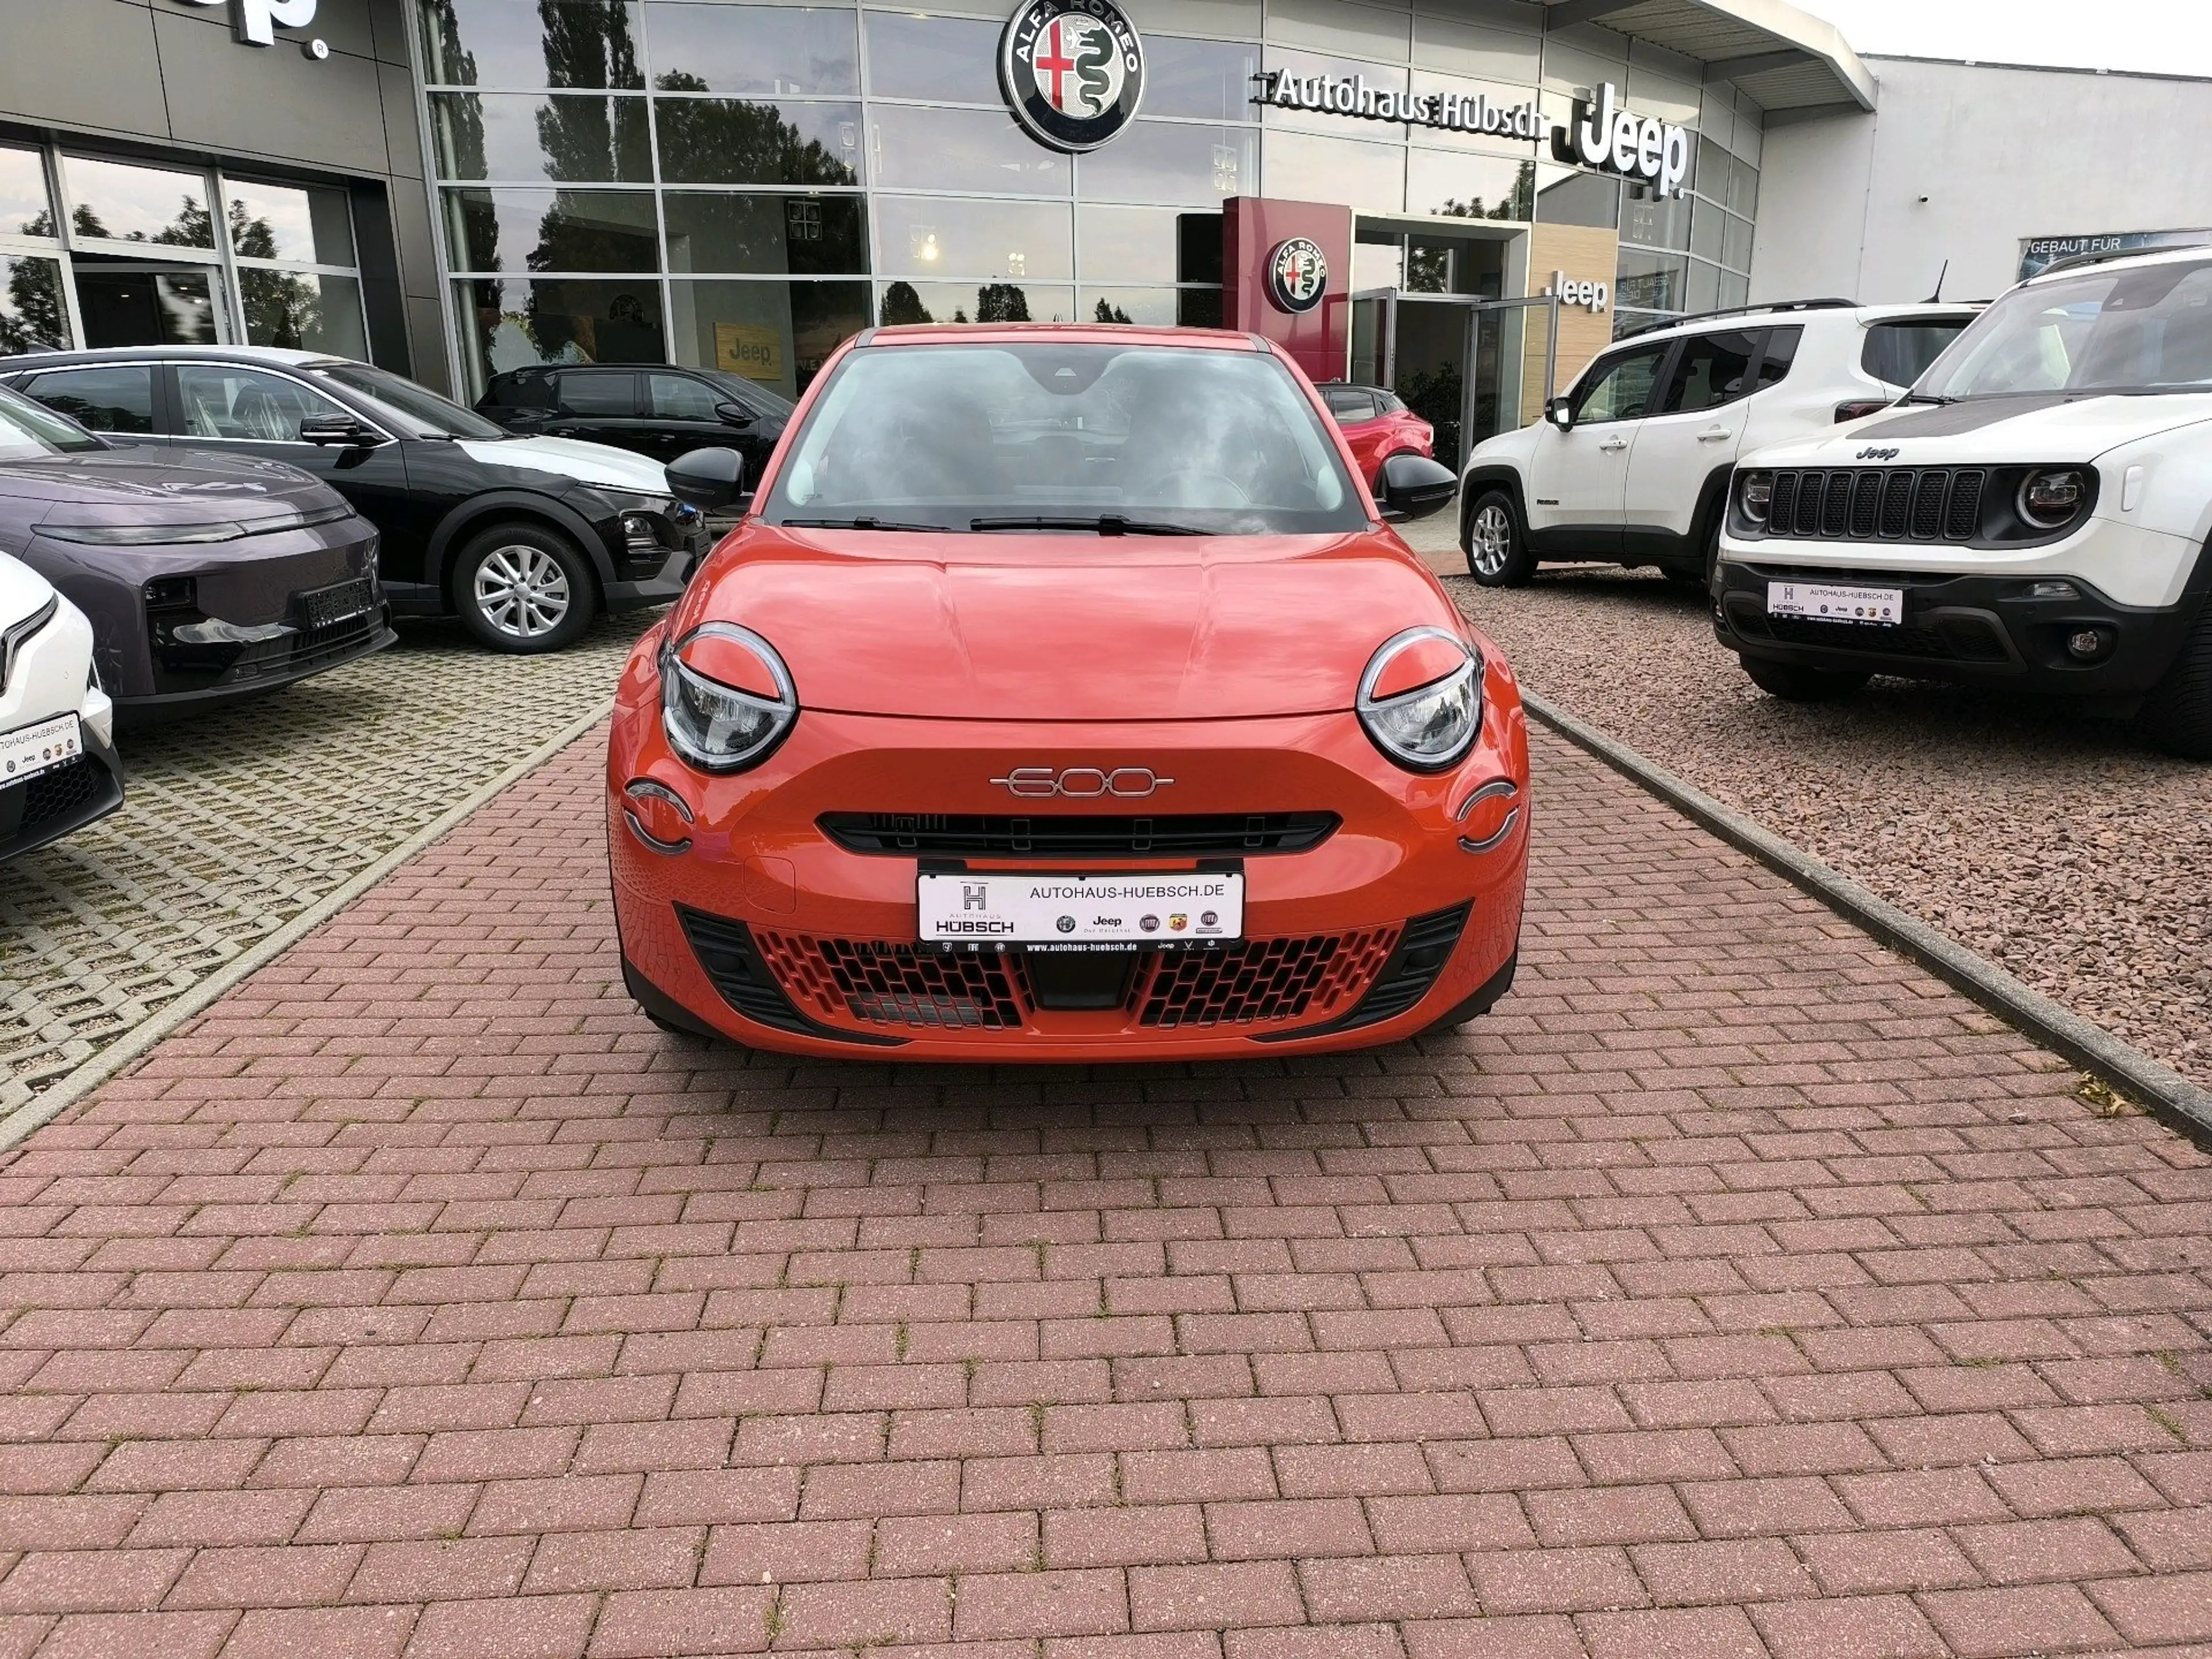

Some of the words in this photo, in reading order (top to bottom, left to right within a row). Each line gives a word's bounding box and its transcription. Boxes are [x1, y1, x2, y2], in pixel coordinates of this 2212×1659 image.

[1016, 1, 1059, 63] ALFA
[1070, 0, 1138, 72] ROMEO
[1274, 68, 1429, 121] Autohaus
[1441, 92, 1544, 138] Hübsch
[1581, 82, 1688, 196] Jeep
[2031, 239, 2085, 253] GEBAUT
[2092, 236, 2121, 251] FÜR
[1278, 245, 1296, 275] ALFA
[1298, 242, 1325, 277] ROMEO
[1546, 270, 1608, 312] Jeep
[729, 338, 771, 366] Jeep
[1856, 447, 1900, 461] Jeep
[1810, 589, 1894, 601] AUTOHAUS-HUEBSCH.DE
[990, 768, 1175, 797] 600
[1030, 884, 1225, 899] AUTOHAUS-HUEBSCH.DE
[937, 921, 1014, 933] HÜBSCH
[1093, 916, 1122, 927] Jeep
[1027, 942, 1137, 951] www.autohaus-huebsch.de
